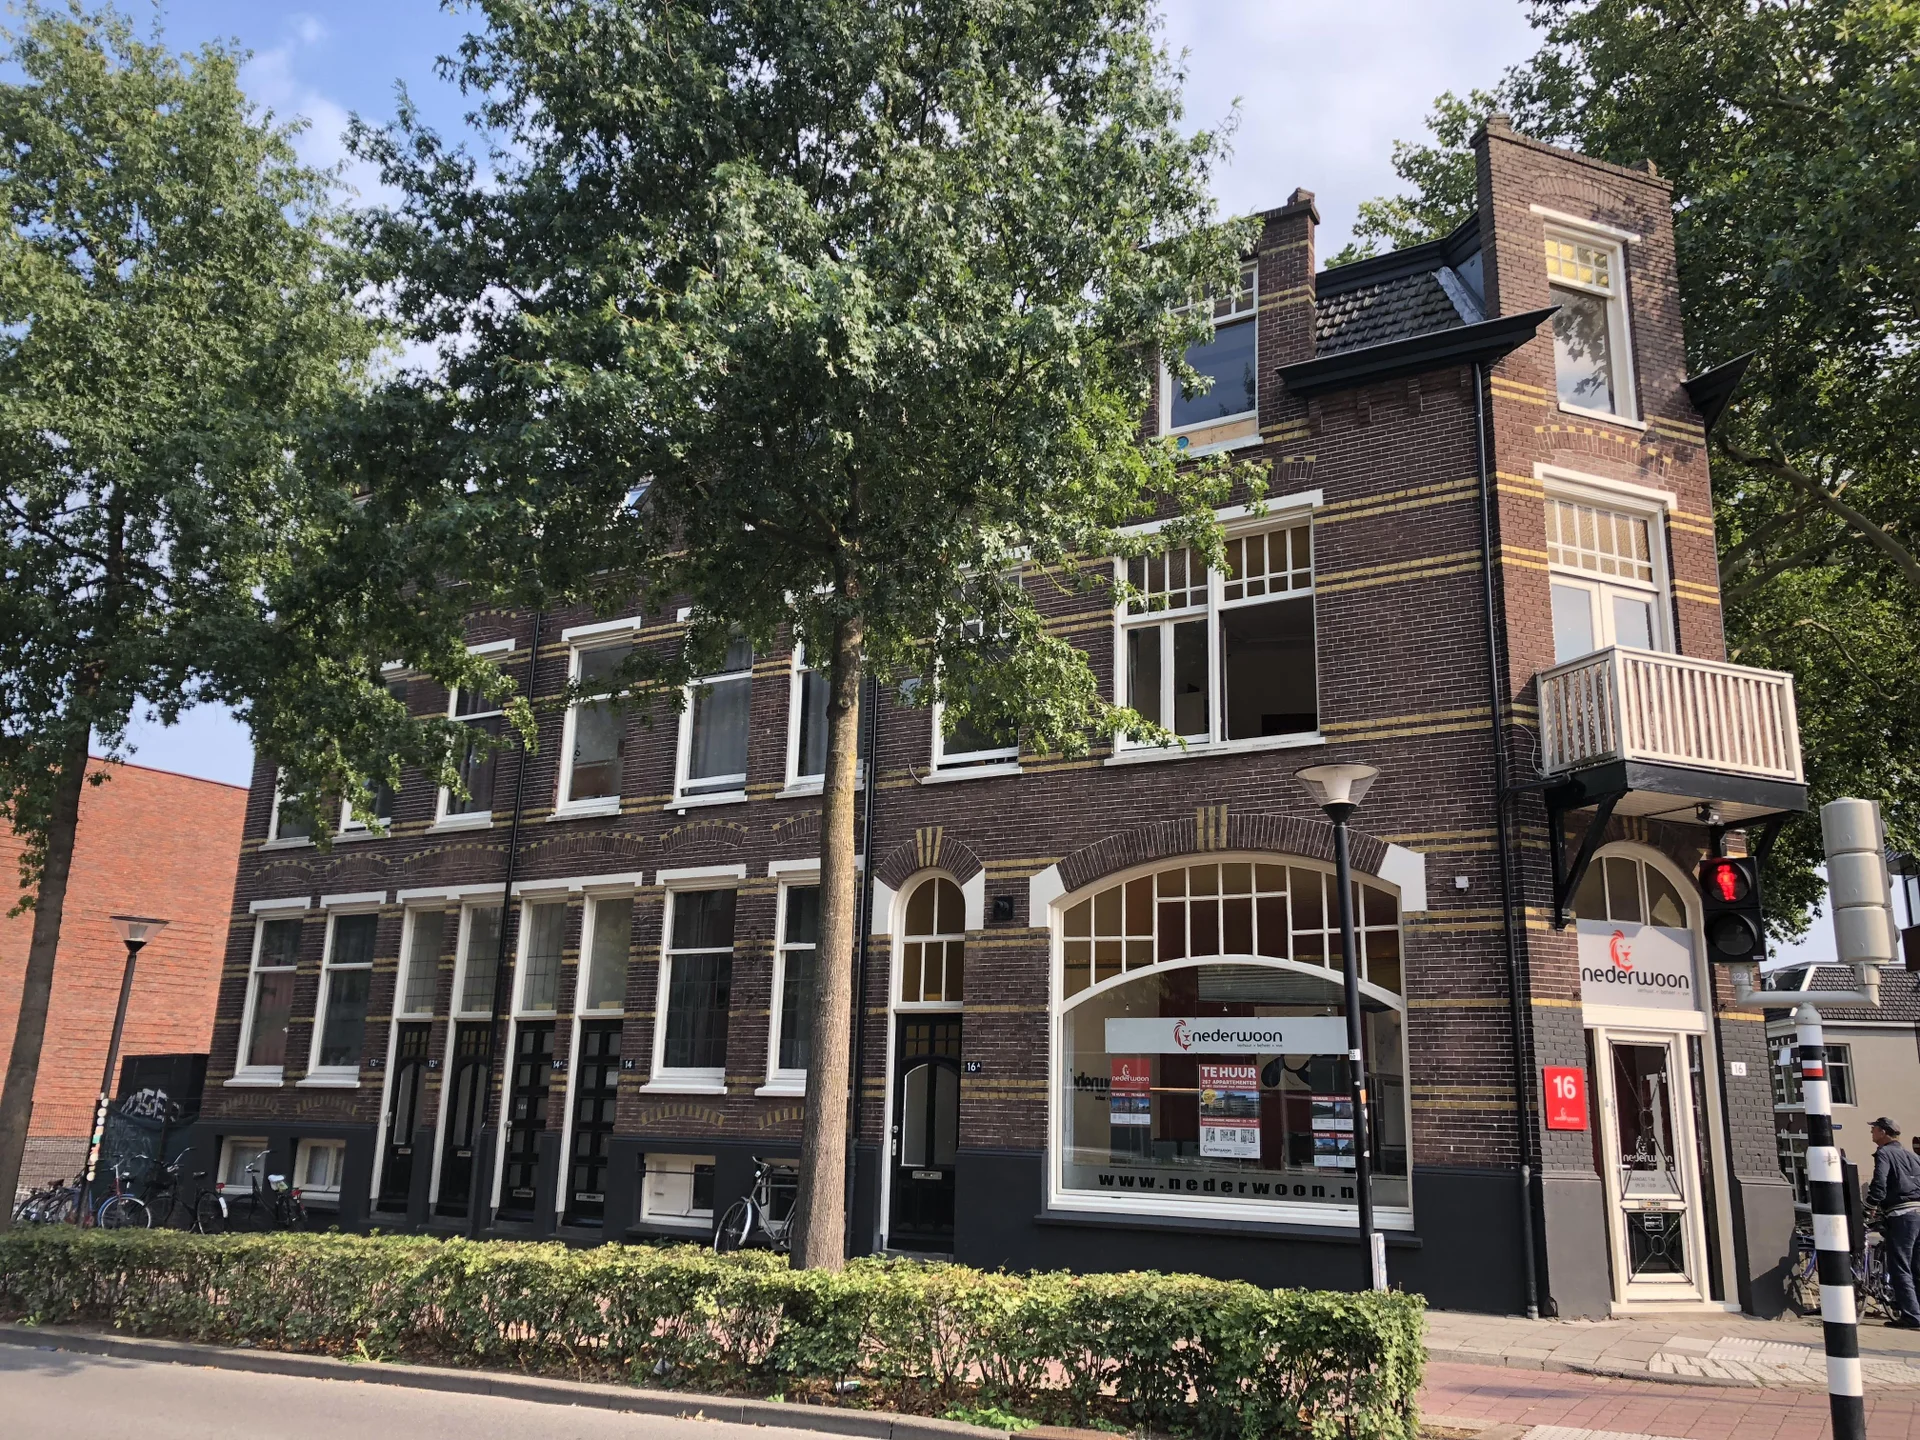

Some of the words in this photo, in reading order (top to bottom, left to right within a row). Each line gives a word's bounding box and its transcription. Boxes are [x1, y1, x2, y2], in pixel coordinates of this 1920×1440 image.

[1582, 965, 1689, 989] nederwoon
[1192, 1029, 1283, 1042] nederwoon
[625, 1060, 632, 1068] 14
[967, 1062, 981, 1071] 16A
[1735, 1064, 1743, 1074] 16
[1201, 1066, 1218, 1078] TE
[1219, 1067, 1257, 1079] HUUR
[1553, 1075, 1577, 1100] 16
[1623, 1152, 1673, 1163] nederwn
[1099, 1173, 1355, 1199] www.nederwoon.n
